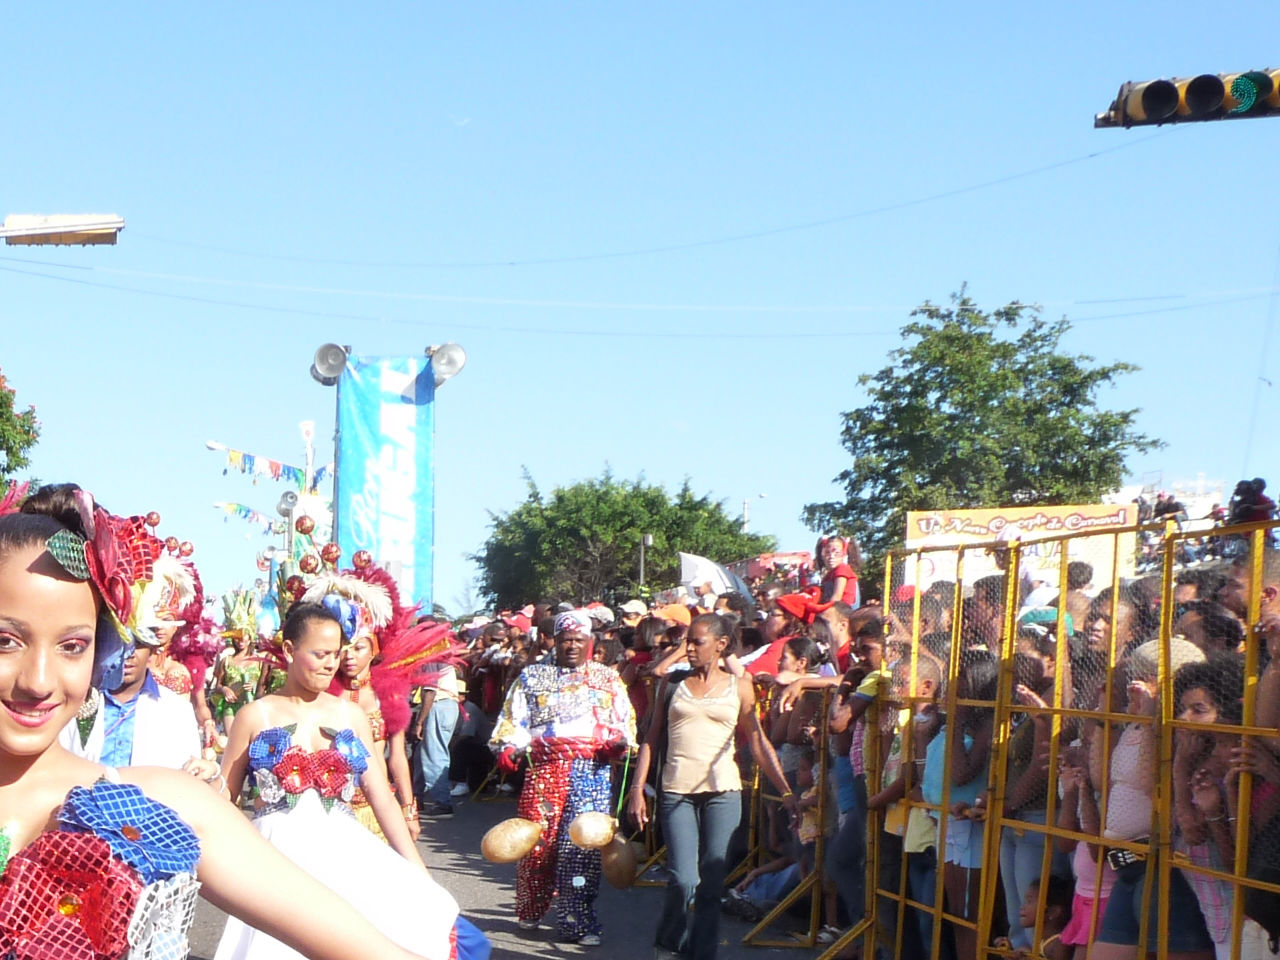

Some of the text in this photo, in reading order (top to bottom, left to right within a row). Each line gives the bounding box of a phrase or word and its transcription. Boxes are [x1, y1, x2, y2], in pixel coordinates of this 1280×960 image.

[988, 512, 1048, 533] Ccepto
[1047, 517, 1062, 530] de
[1064, 509, 1126, 530] Carnaval
